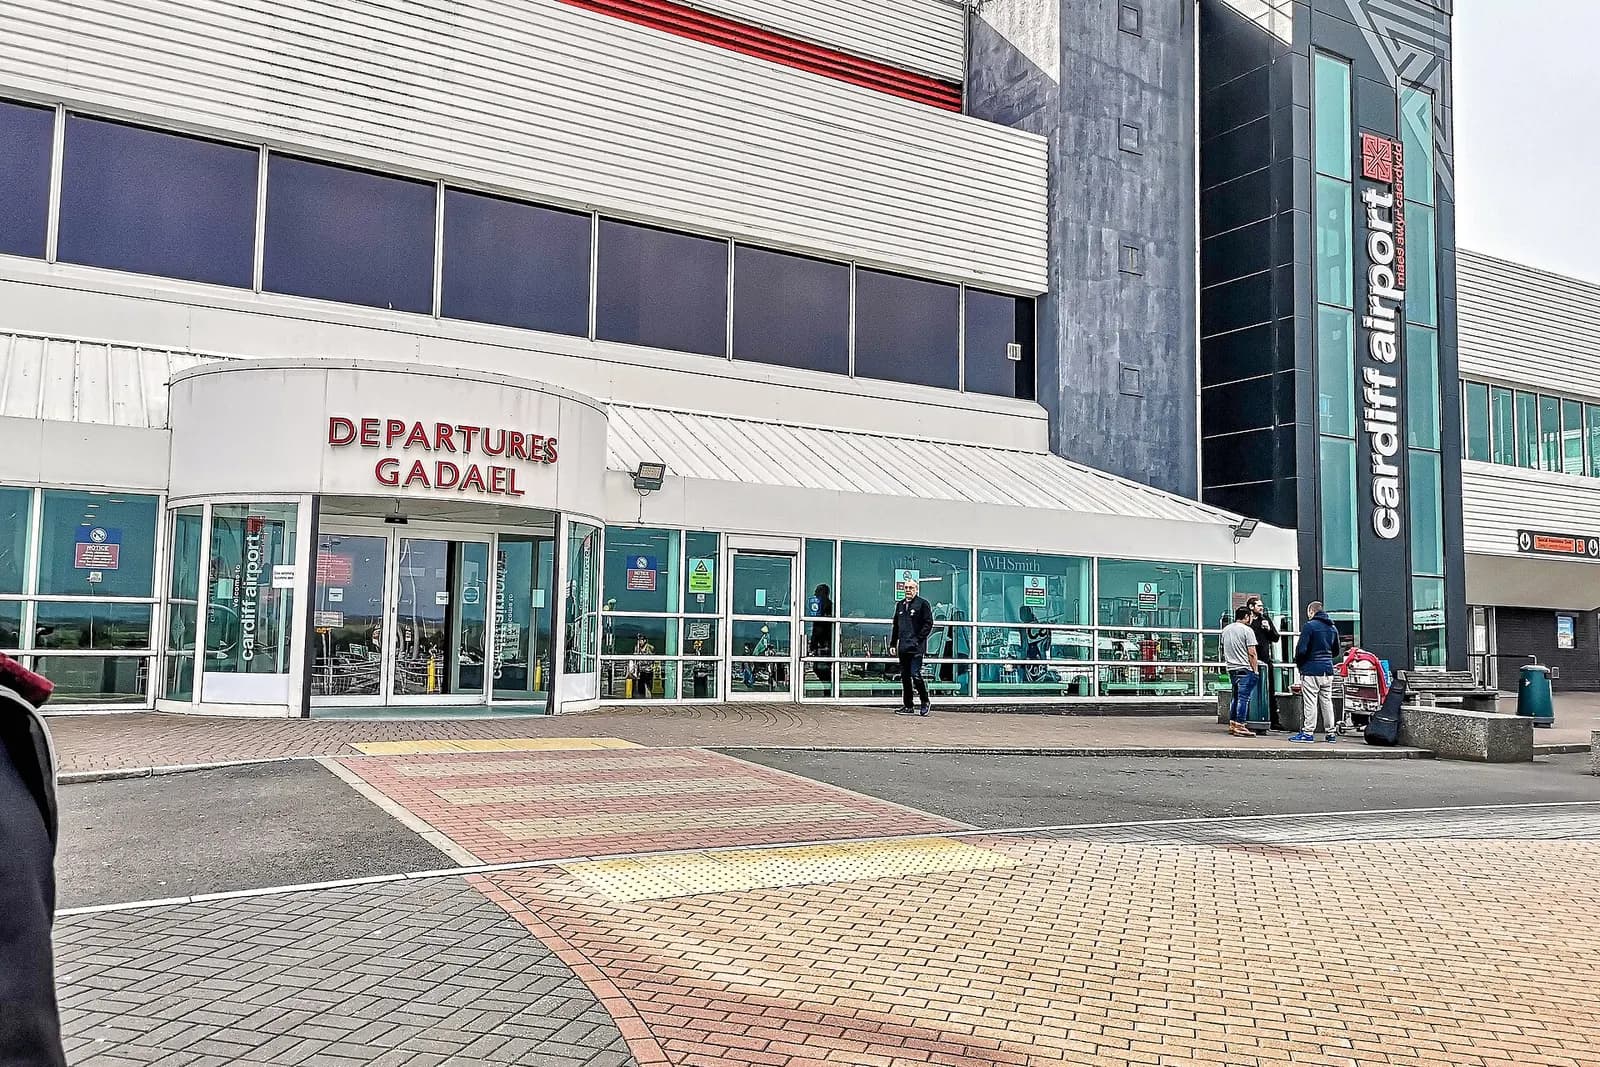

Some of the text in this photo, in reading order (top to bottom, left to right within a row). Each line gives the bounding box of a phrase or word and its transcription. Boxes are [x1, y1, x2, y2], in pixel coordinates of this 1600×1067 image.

[1391, 142, 1406, 286] maes awyr caerdydd
[1361, 187, 1404, 539] cardiff airport
[328, 416, 558, 464] DEPARTURES
[374, 458, 525, 496] GADAEL
[241, 534, 262, 661] cardiff airport
[983, 555, 1040, 572] WHSmith
